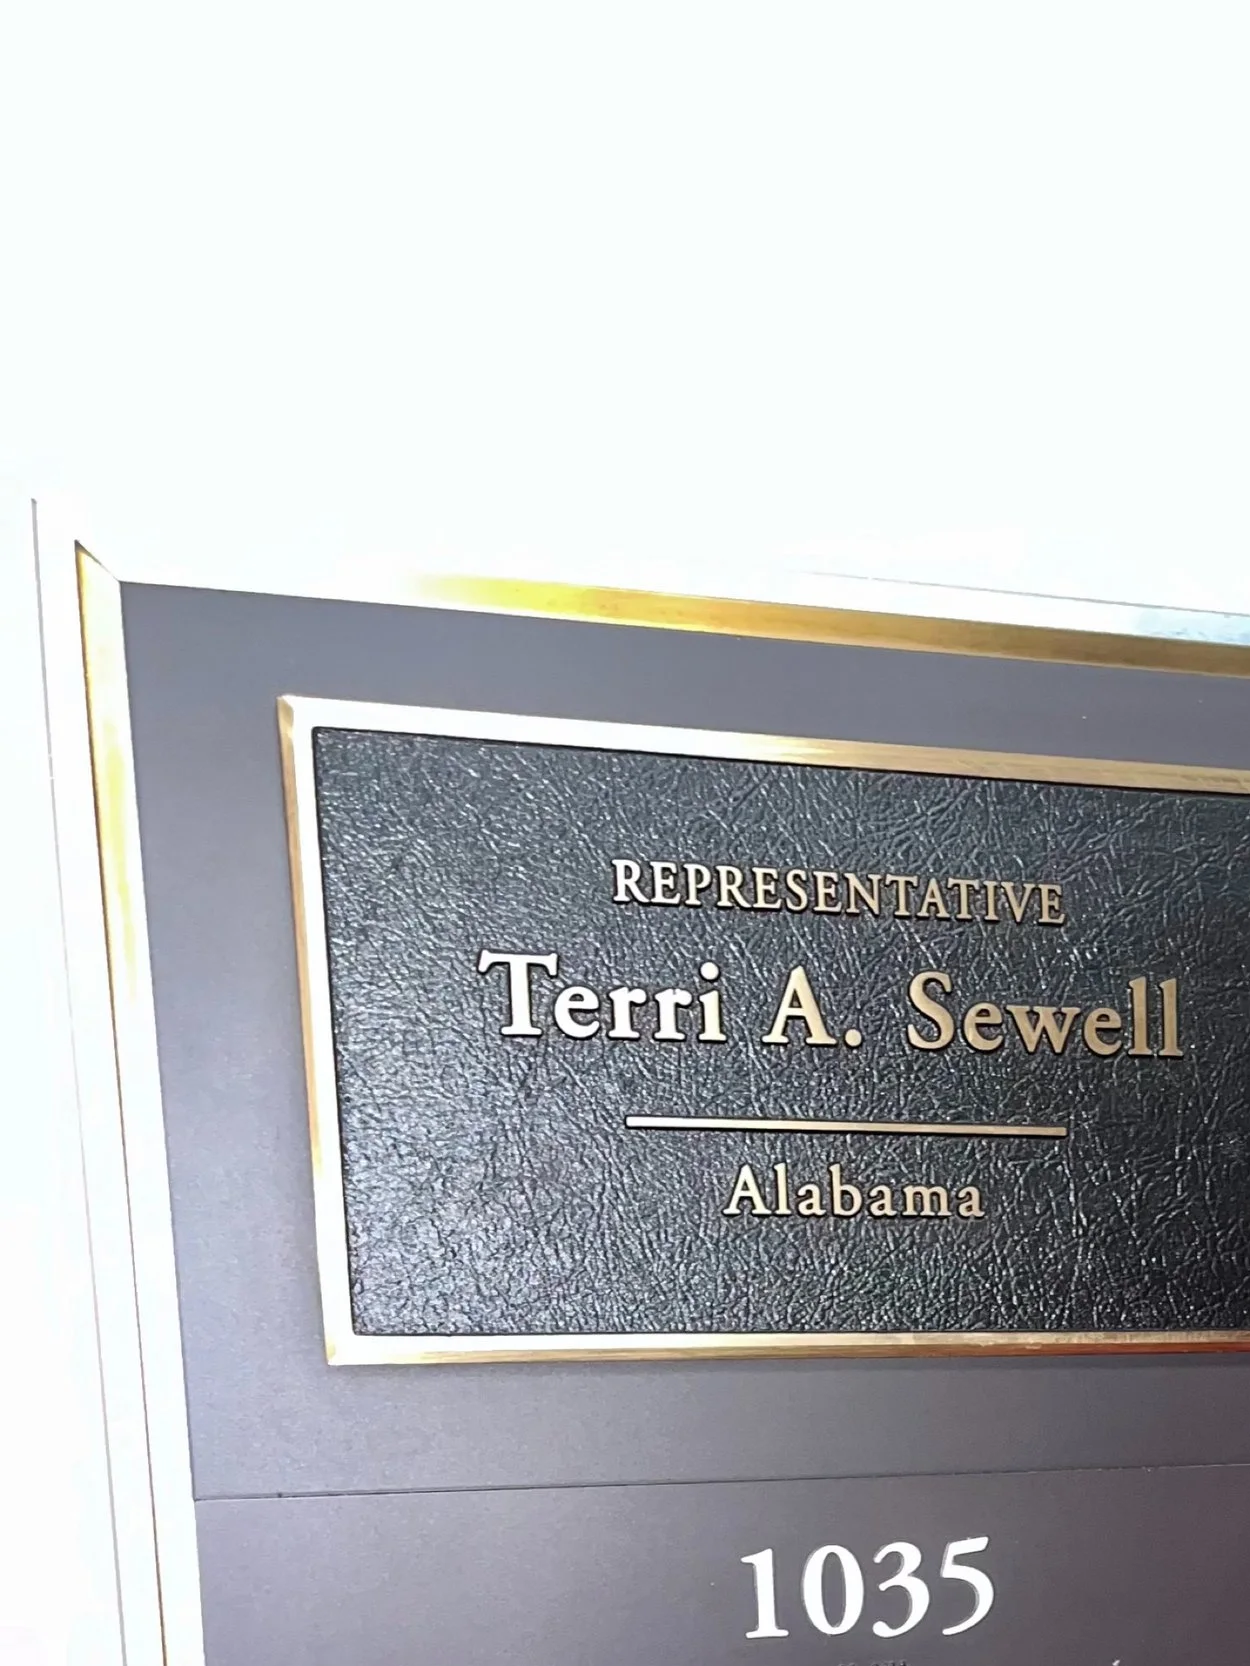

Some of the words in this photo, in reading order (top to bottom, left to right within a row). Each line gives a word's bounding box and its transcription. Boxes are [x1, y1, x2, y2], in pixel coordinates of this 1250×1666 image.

[611, 858, 1067, 926] REPRESENTATIVE
[478, 950, 727, 1043] Terri
[762, 966, 864, 1048] A.
[906, 970, 1184, 1058] Sewell
[722, 1163, 986, 1218] Alabama
[740, 1536, 995, 1640] 1035
